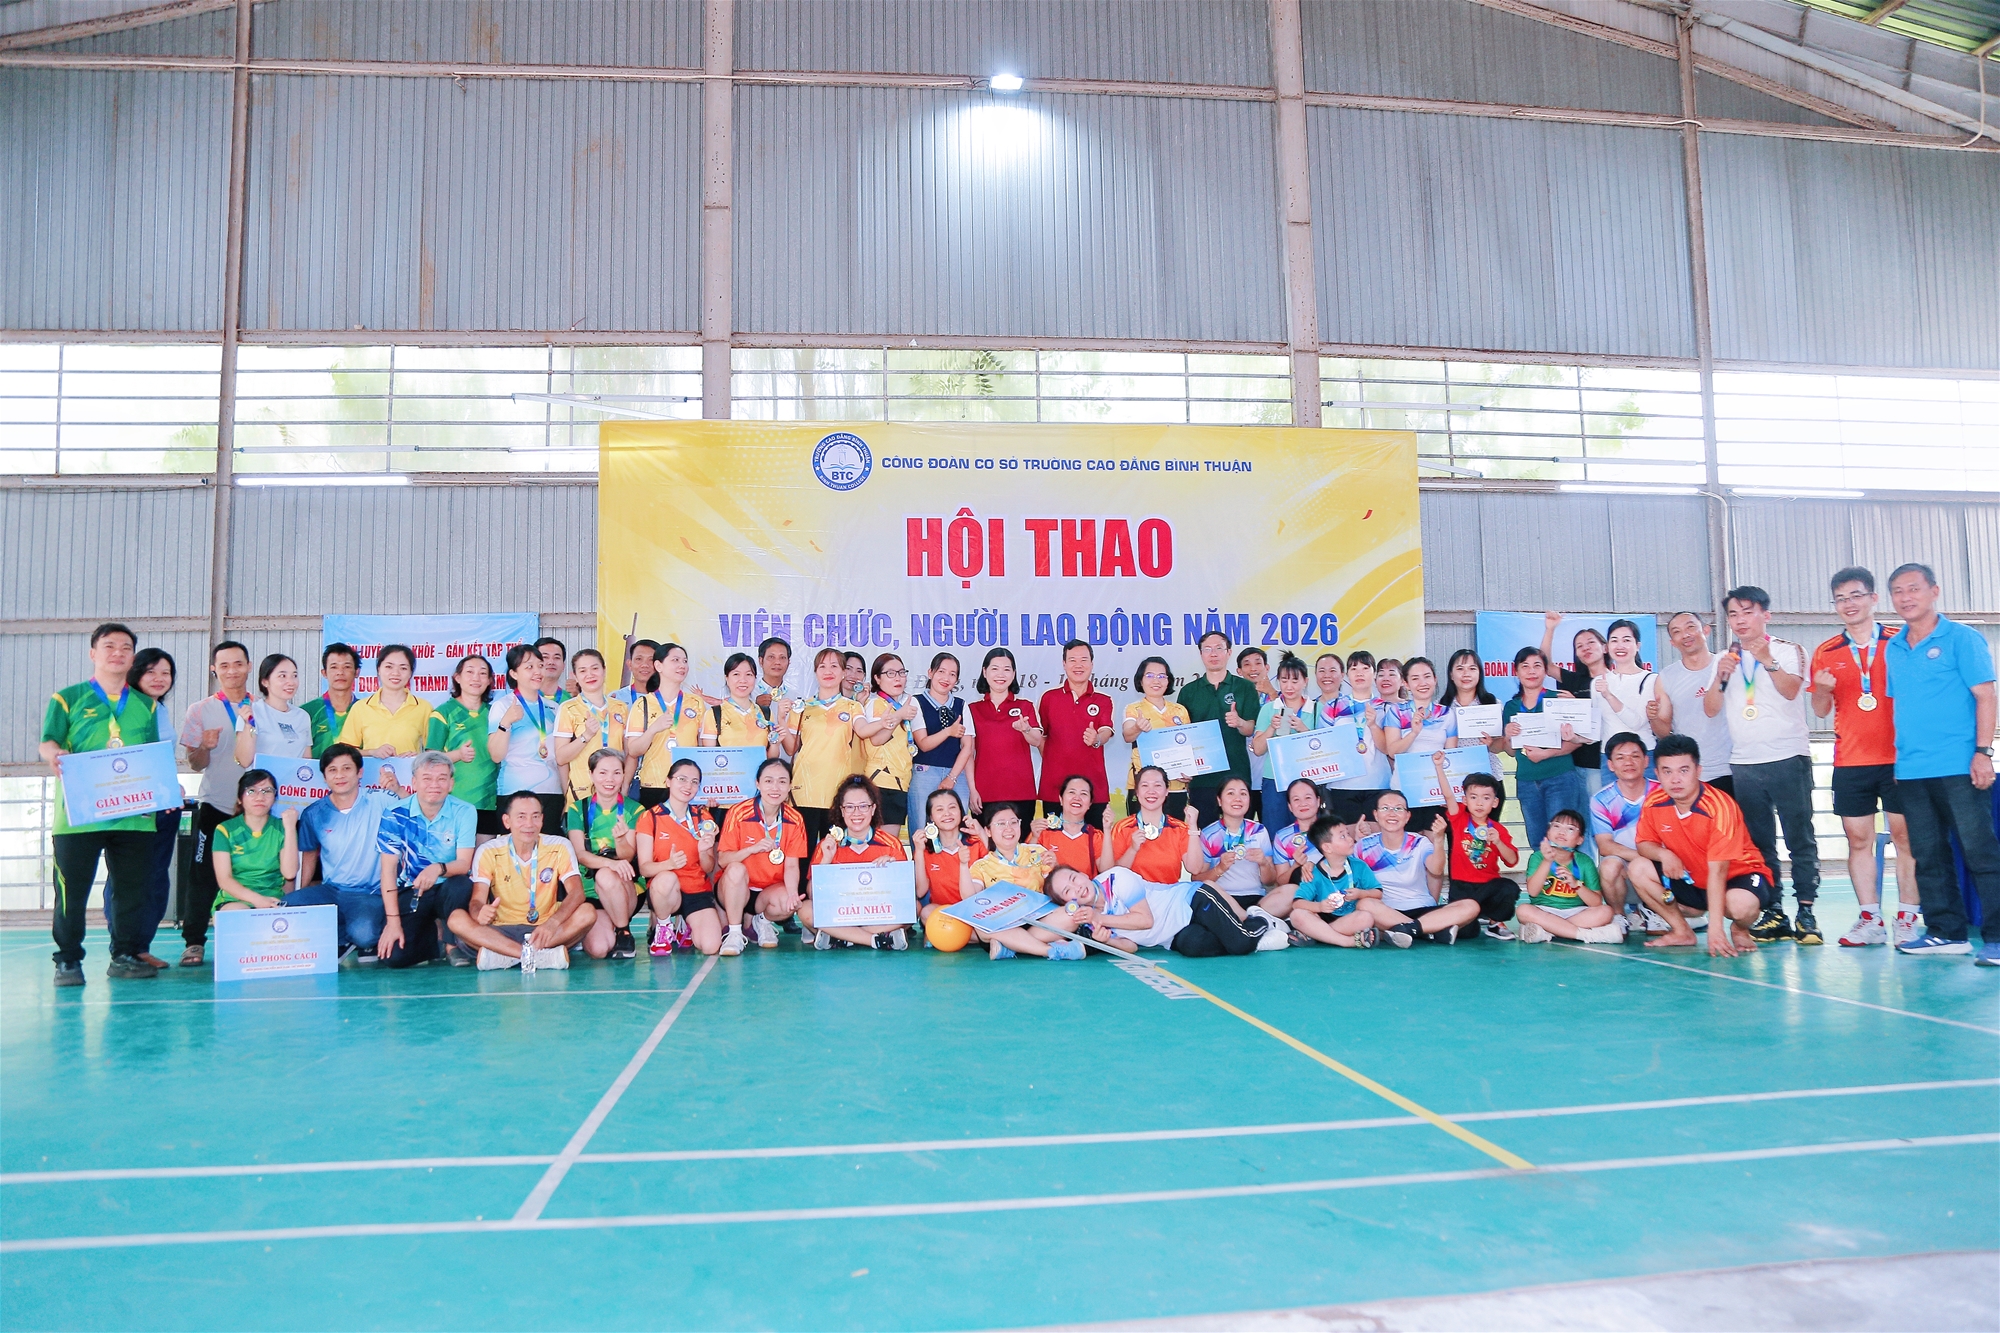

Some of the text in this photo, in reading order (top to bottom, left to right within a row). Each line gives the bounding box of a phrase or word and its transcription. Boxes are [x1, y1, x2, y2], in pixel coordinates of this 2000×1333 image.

[882, 455, 1252, 474] CÔNG ĐOÀN CƠ SỞ TRƯỜNG CAO ĐẲNG BÌNH THUẬN
[831, 471, 853, 480] BTC
[906, 507, 1172, 589] HỘI THAO
[718, 607, 791, 647] VIÊN
[803, 608, 899, 650] CHỨC,
[911, 607, 1009, 647] NGƯỜI
[1020, 613, 1076, 646] LAO
[1087, 607, 1172, 652] ĐỘNG
[1261, 613, 1338, 646] 2026
[412, 642, 435, 659] KHỎE
[446, 640, 464, 658] GẮN
[467, 640, 483, 656] KẾT
[485, 641, 504, 659] TẬP
[1484, 659, 1508, 677] ĐOÀN
[359, 676, 380, 692] ĐUA
[414, 673, 448, 692] THÀNH
[1019, 673, 1038, 689] 18
[1092, 673, 1130, 692] háng
[1301, 766, 1321, 778] GIẢI
[1322, 762, 1340, 774] NHÌ
[280, 784, 307, 798] CÔNG
[703, 783, 740, 794] GIẢI BA
[96, 789, 154, 809] GIẢI NHẤT
[838, 901, 893, 915] GIẢI NHẤT
[239, 950, 318, 964] GIẢI PHONG CÁCH
